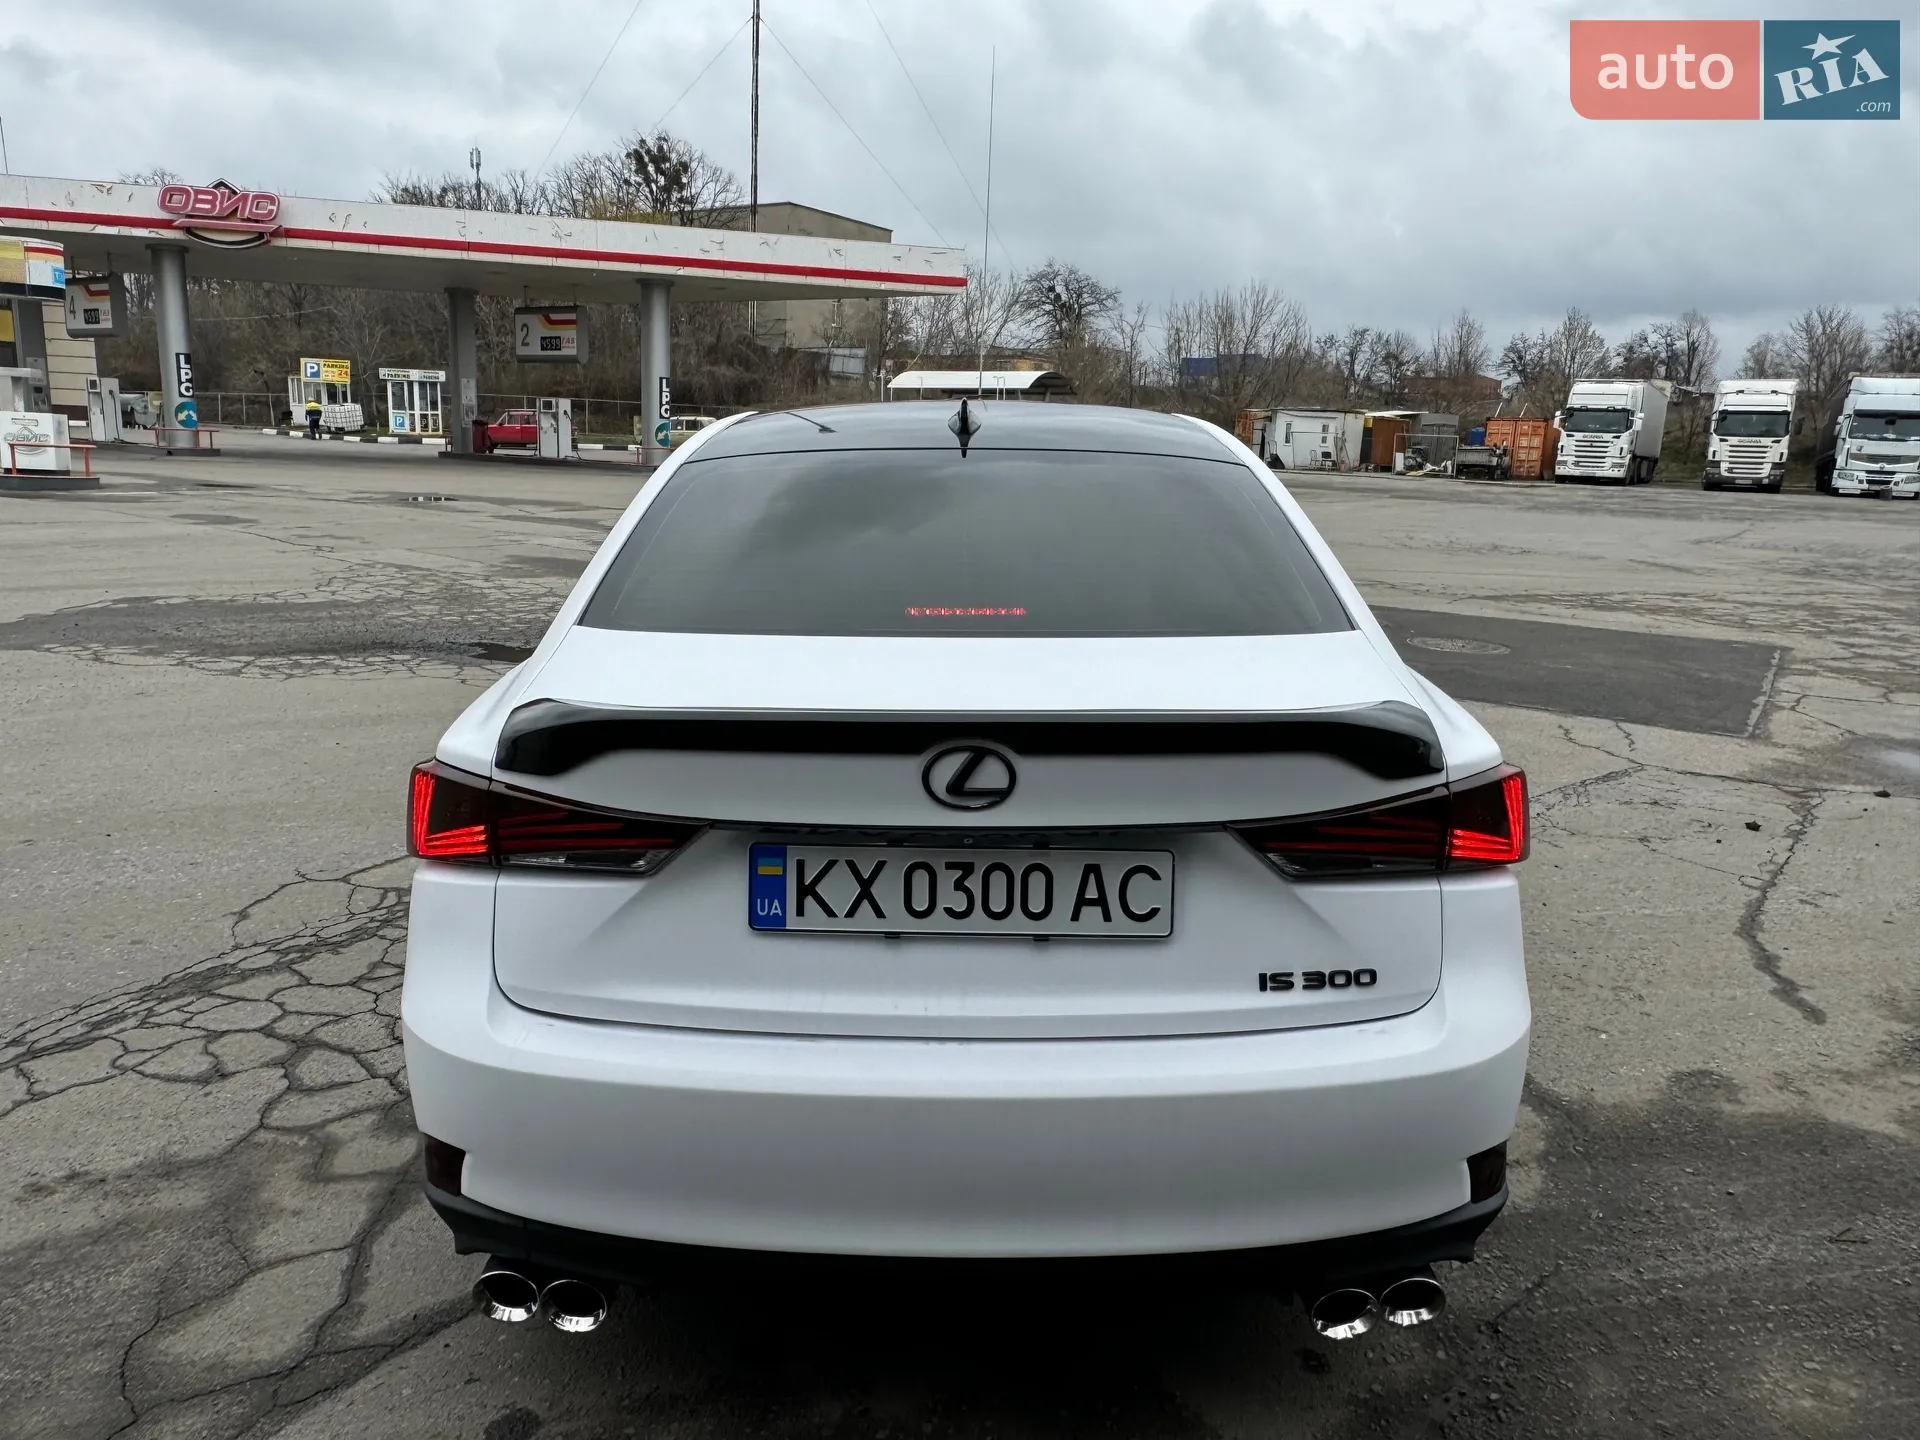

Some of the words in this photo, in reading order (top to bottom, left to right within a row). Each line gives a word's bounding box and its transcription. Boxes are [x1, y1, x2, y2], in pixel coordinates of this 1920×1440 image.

[159, 184, 280, 221] ОВИС
[69, 295, 77, 320] 4
[521, 323, 530, 346] 2
[179, 355, 193, 396] LPG
[306, 363, 318, 377] P
[795, 858, 888, 919] KX
[902, 860, 1054, 922] 0300
[1069, 862, 1162, 923] AC
[756, 898, 783, 917] UA
[1258, 972, 1295, 992] IS
[1301, 968, 1378, 990] 300
